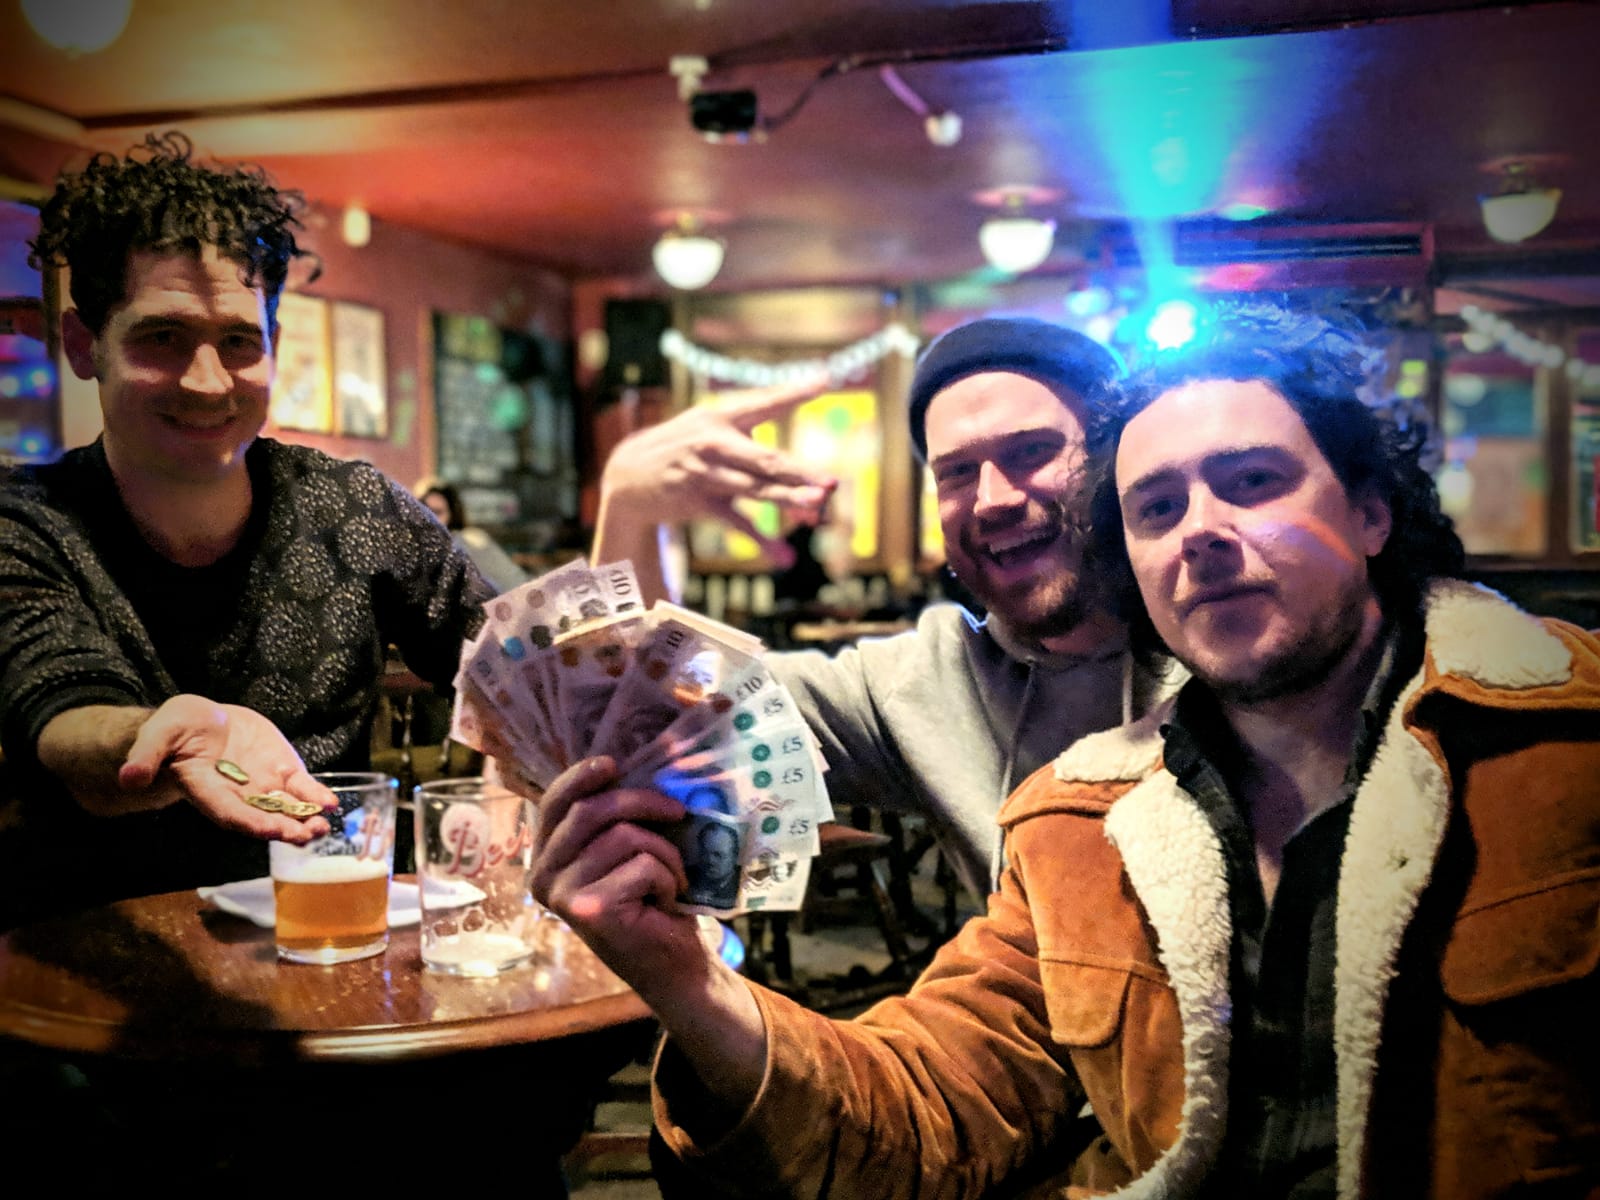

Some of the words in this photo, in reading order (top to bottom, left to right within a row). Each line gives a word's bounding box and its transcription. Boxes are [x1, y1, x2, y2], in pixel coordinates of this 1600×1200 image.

[763, 697, 784, 716] £5
[781, 736, 803, 755] £5
[781, 767, 804, 784] £5
[788, 818, 810, 835] £5
